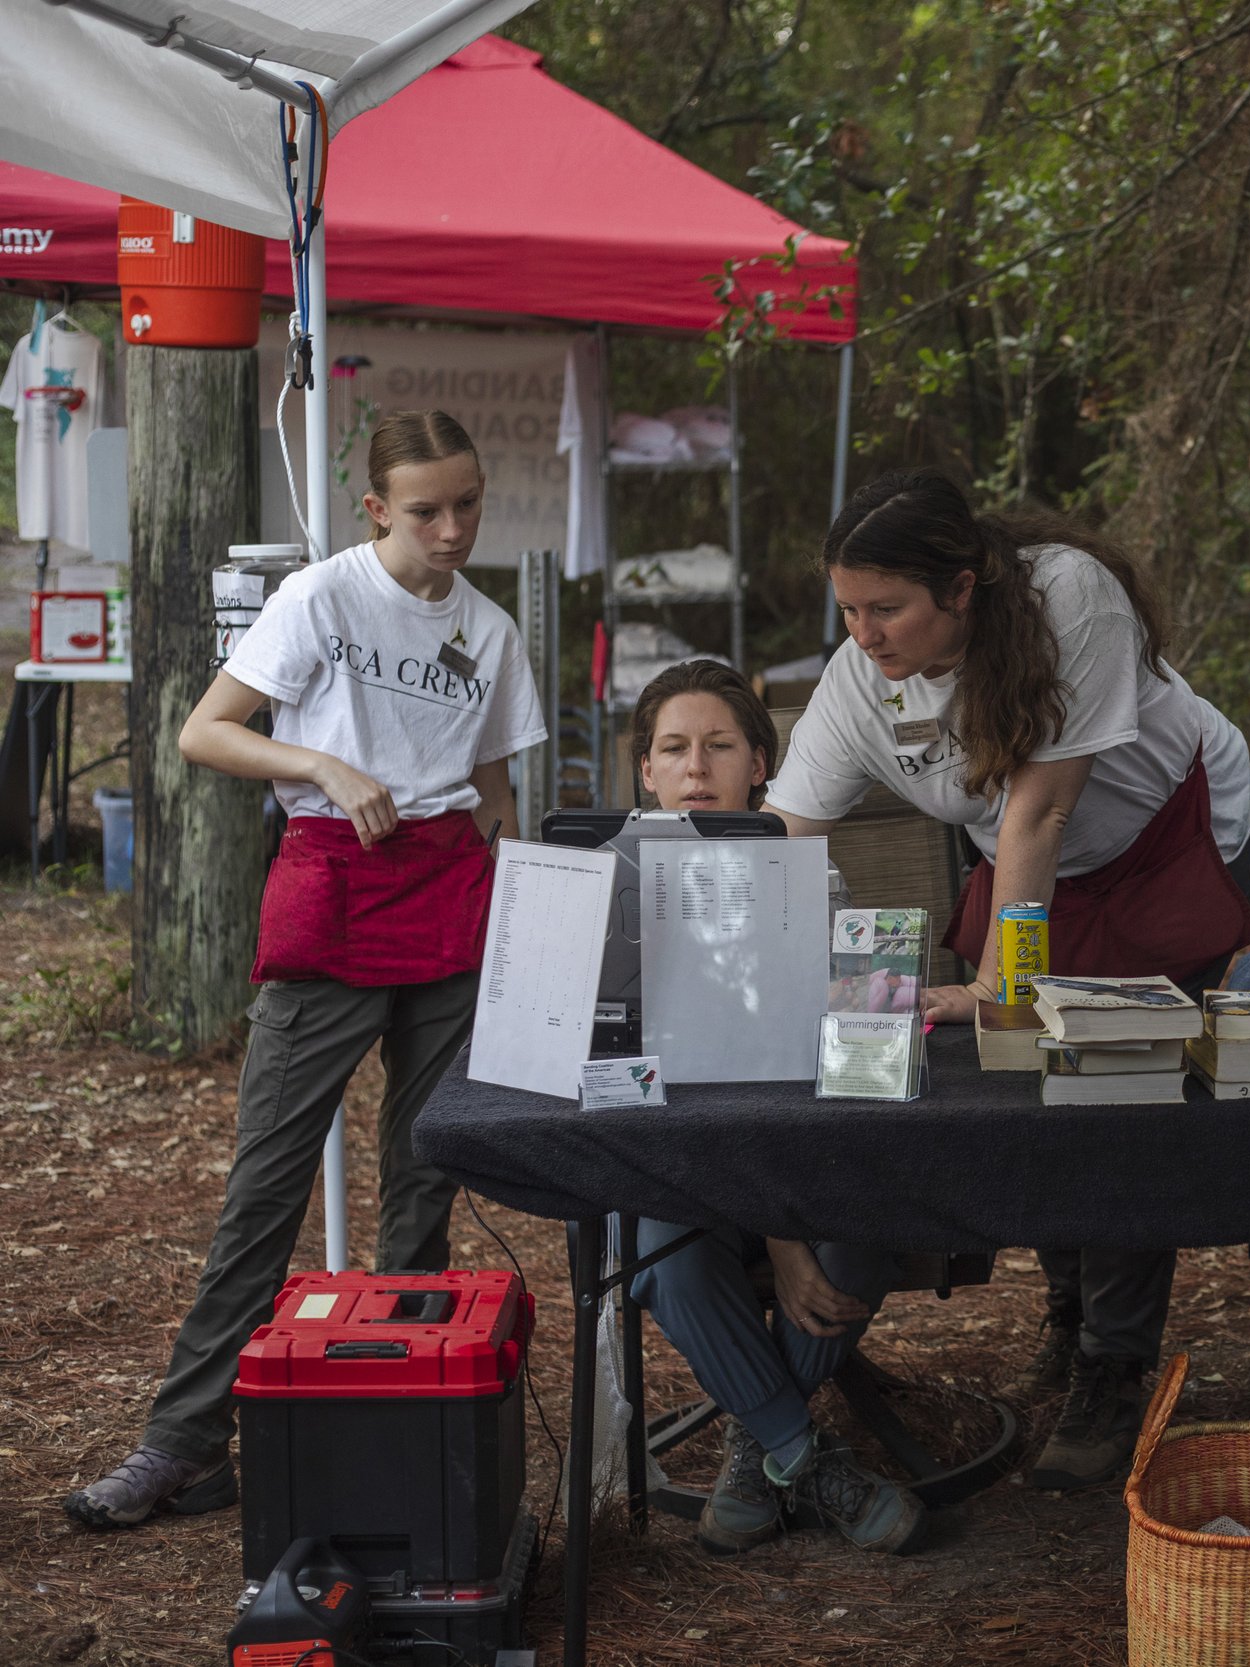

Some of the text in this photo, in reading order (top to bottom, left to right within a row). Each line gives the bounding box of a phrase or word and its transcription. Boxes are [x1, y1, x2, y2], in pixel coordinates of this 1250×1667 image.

[0, 228, 55, 252] my
[329, 635, 382, 678] BCA
[397, 657, 491, 706] CREW
[895, 728, 967, 776] BCA
[838, 1019, 903, 1031] ummingbirds
